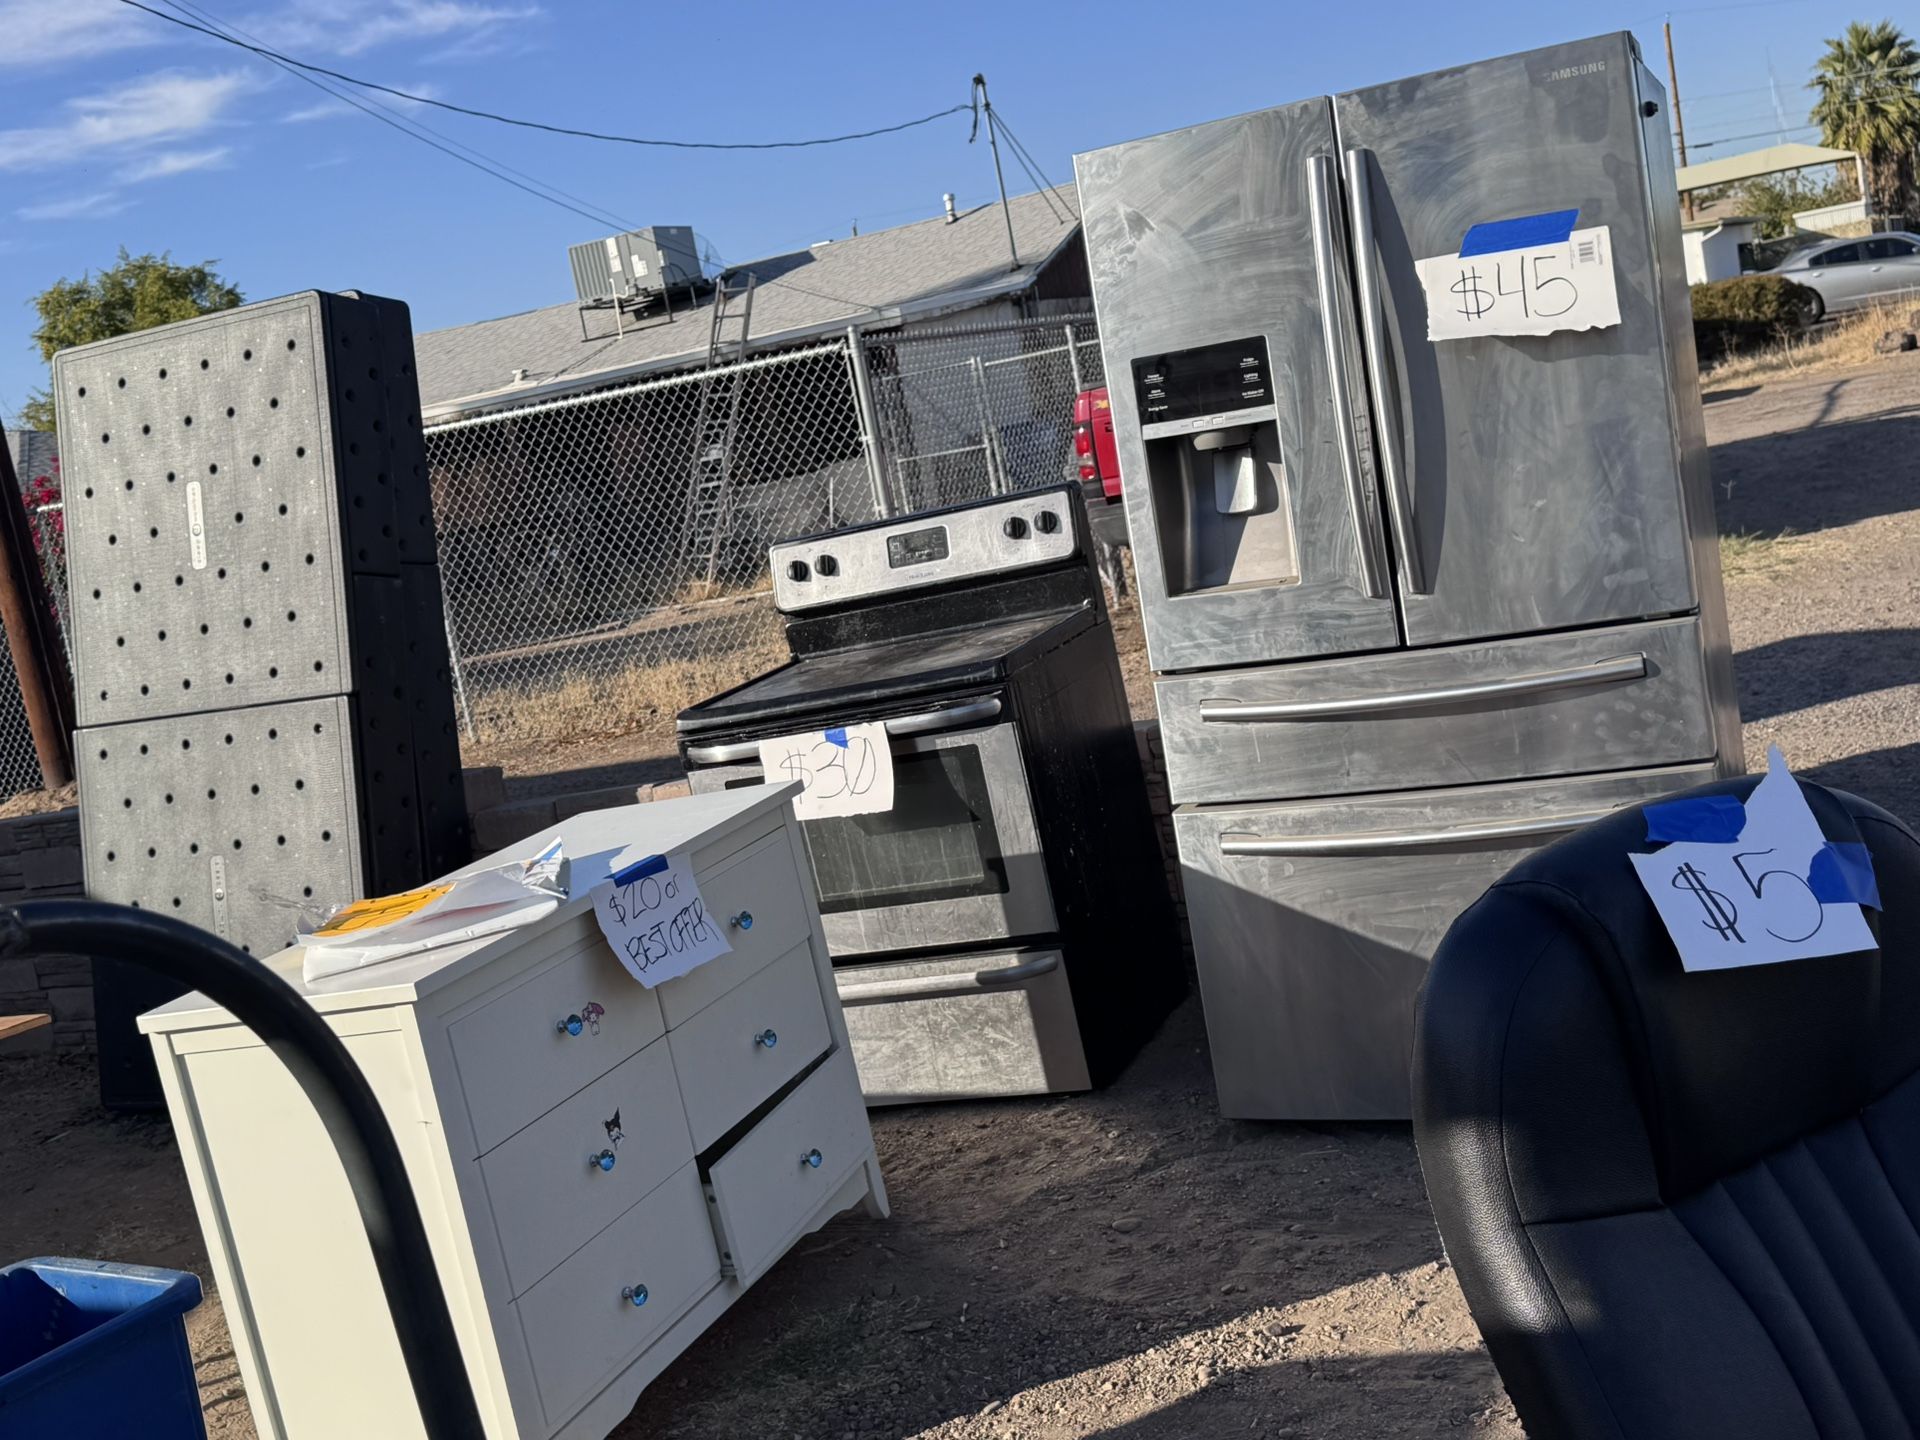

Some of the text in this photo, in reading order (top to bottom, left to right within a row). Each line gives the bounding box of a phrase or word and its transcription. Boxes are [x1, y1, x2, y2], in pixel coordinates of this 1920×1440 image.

[1450, 254, 1578, 322] $45
[779, 736, 877, 805] $30
[608, 872, 680, 927] $20 or
[1671, 848, 1823, 944] $5
[624, 896, 720, 974] BEST OFFER
